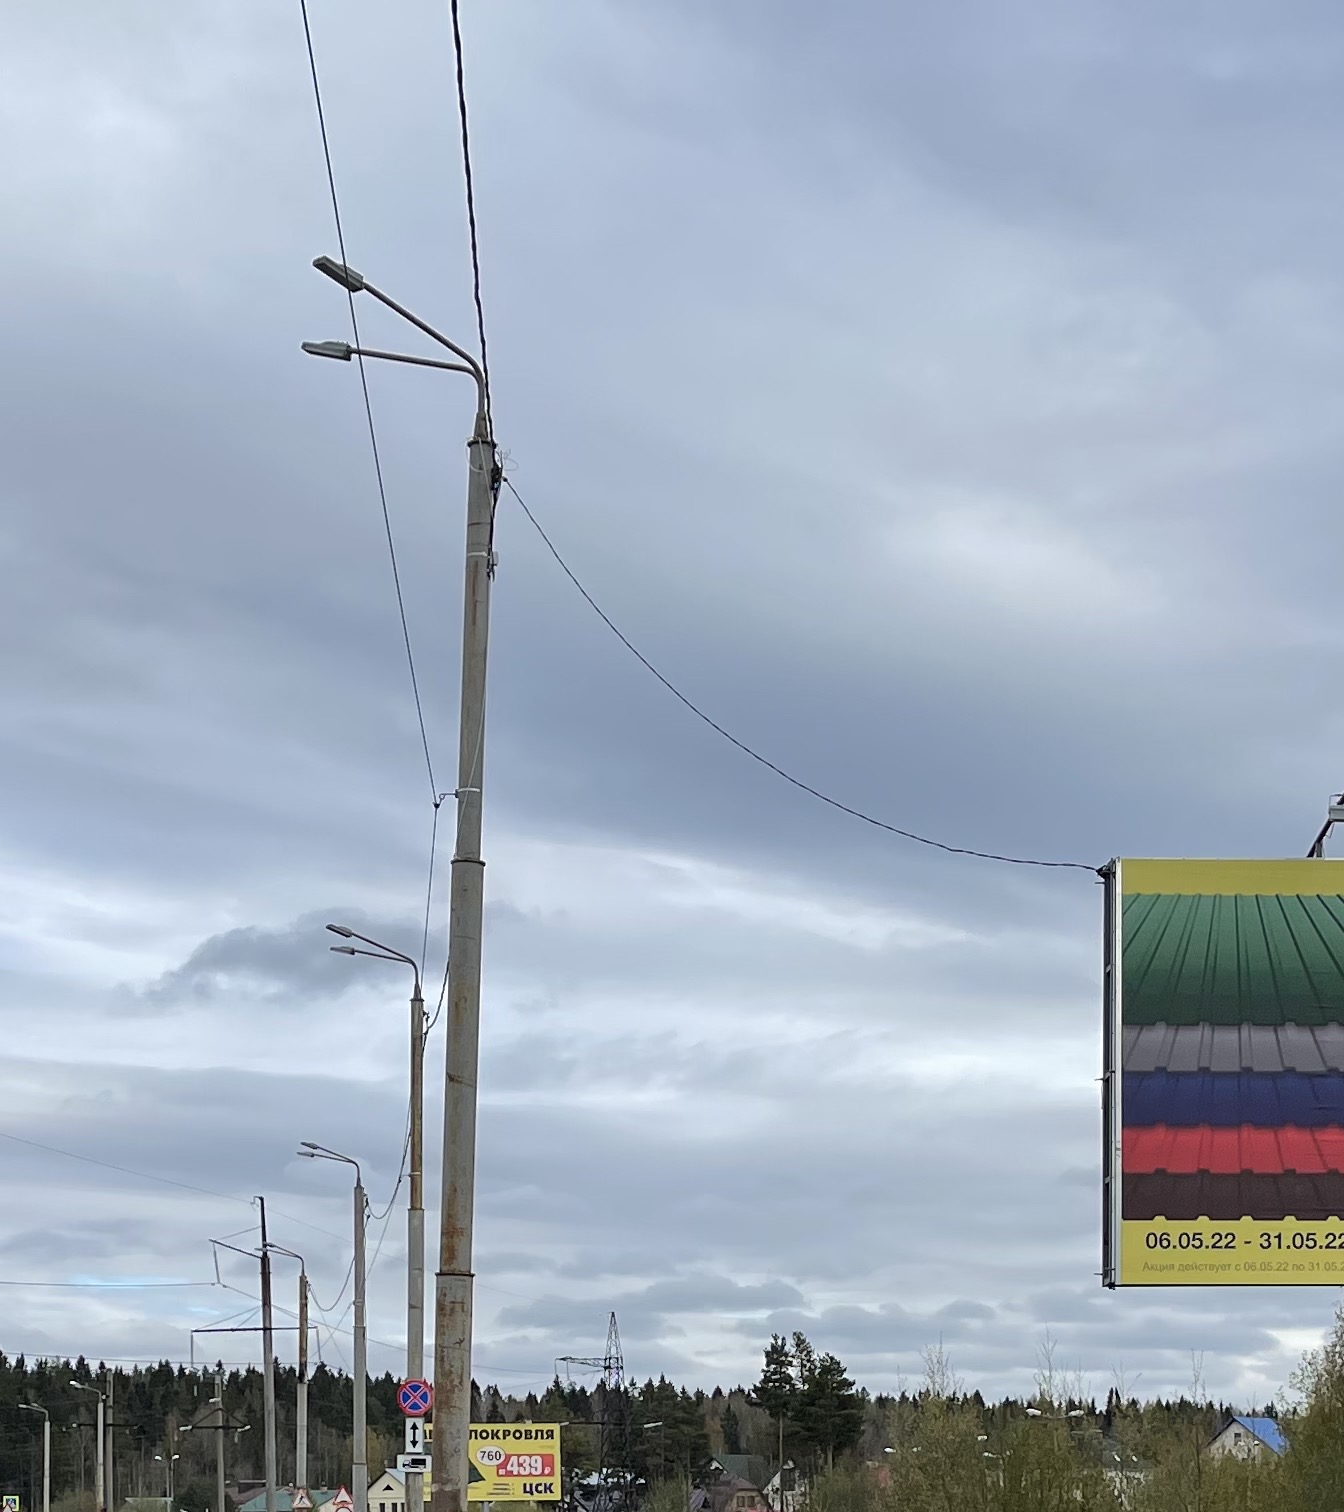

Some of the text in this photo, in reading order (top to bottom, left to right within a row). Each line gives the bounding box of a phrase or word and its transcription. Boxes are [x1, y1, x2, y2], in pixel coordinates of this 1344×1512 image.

[1145, 1232, 1236, 1250] 06.05.22
[480, 1450, 501, 1461] 760
[506, 1455, 543, 1475] 439
[523, 1482, 554, 1495] ЦСК
